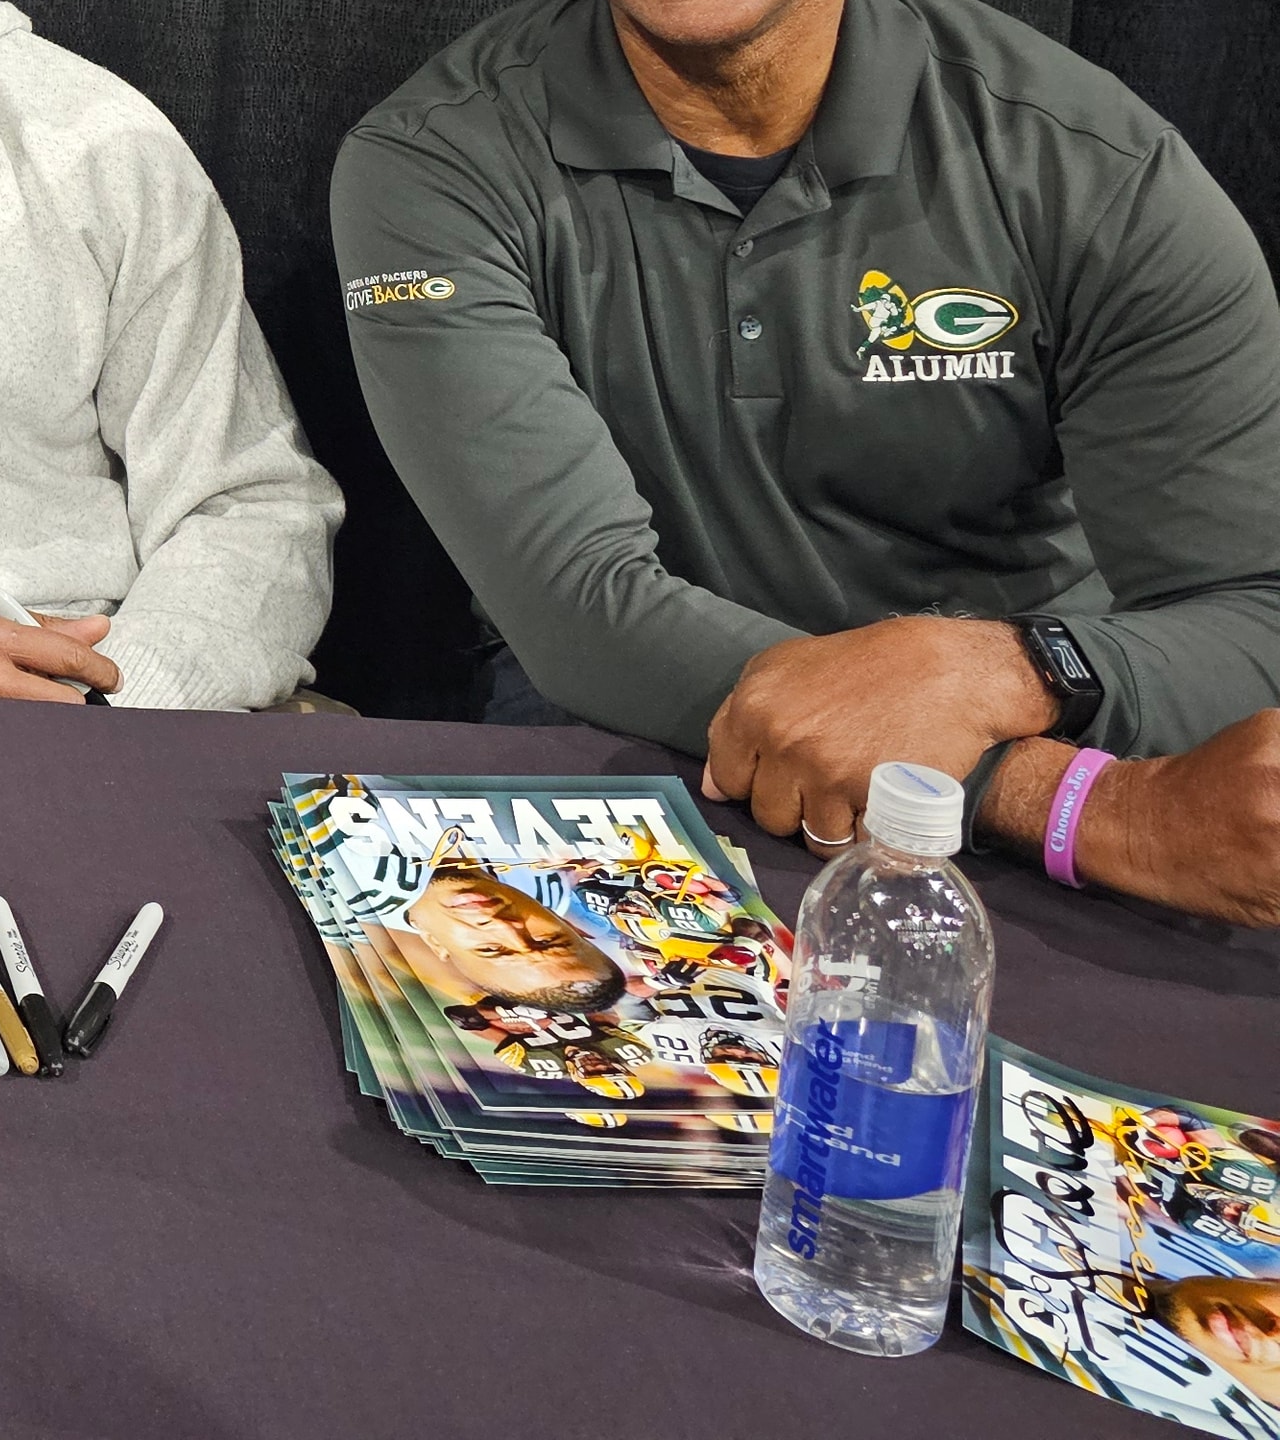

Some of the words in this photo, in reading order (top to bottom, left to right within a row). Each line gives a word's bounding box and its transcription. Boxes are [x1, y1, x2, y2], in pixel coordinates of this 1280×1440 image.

[364, 275, 380, 286] BAY
[382, 270, 428, 283] PACKERS
[862, 351, 1015, 383] ALUMNI
[328, 795, 688, 859] LEVENS
[1049, 787, 1079, 853] Choose
[1067, 763, 1091, 791] Joy
[786, 1016, 847, 1260] smartwater
